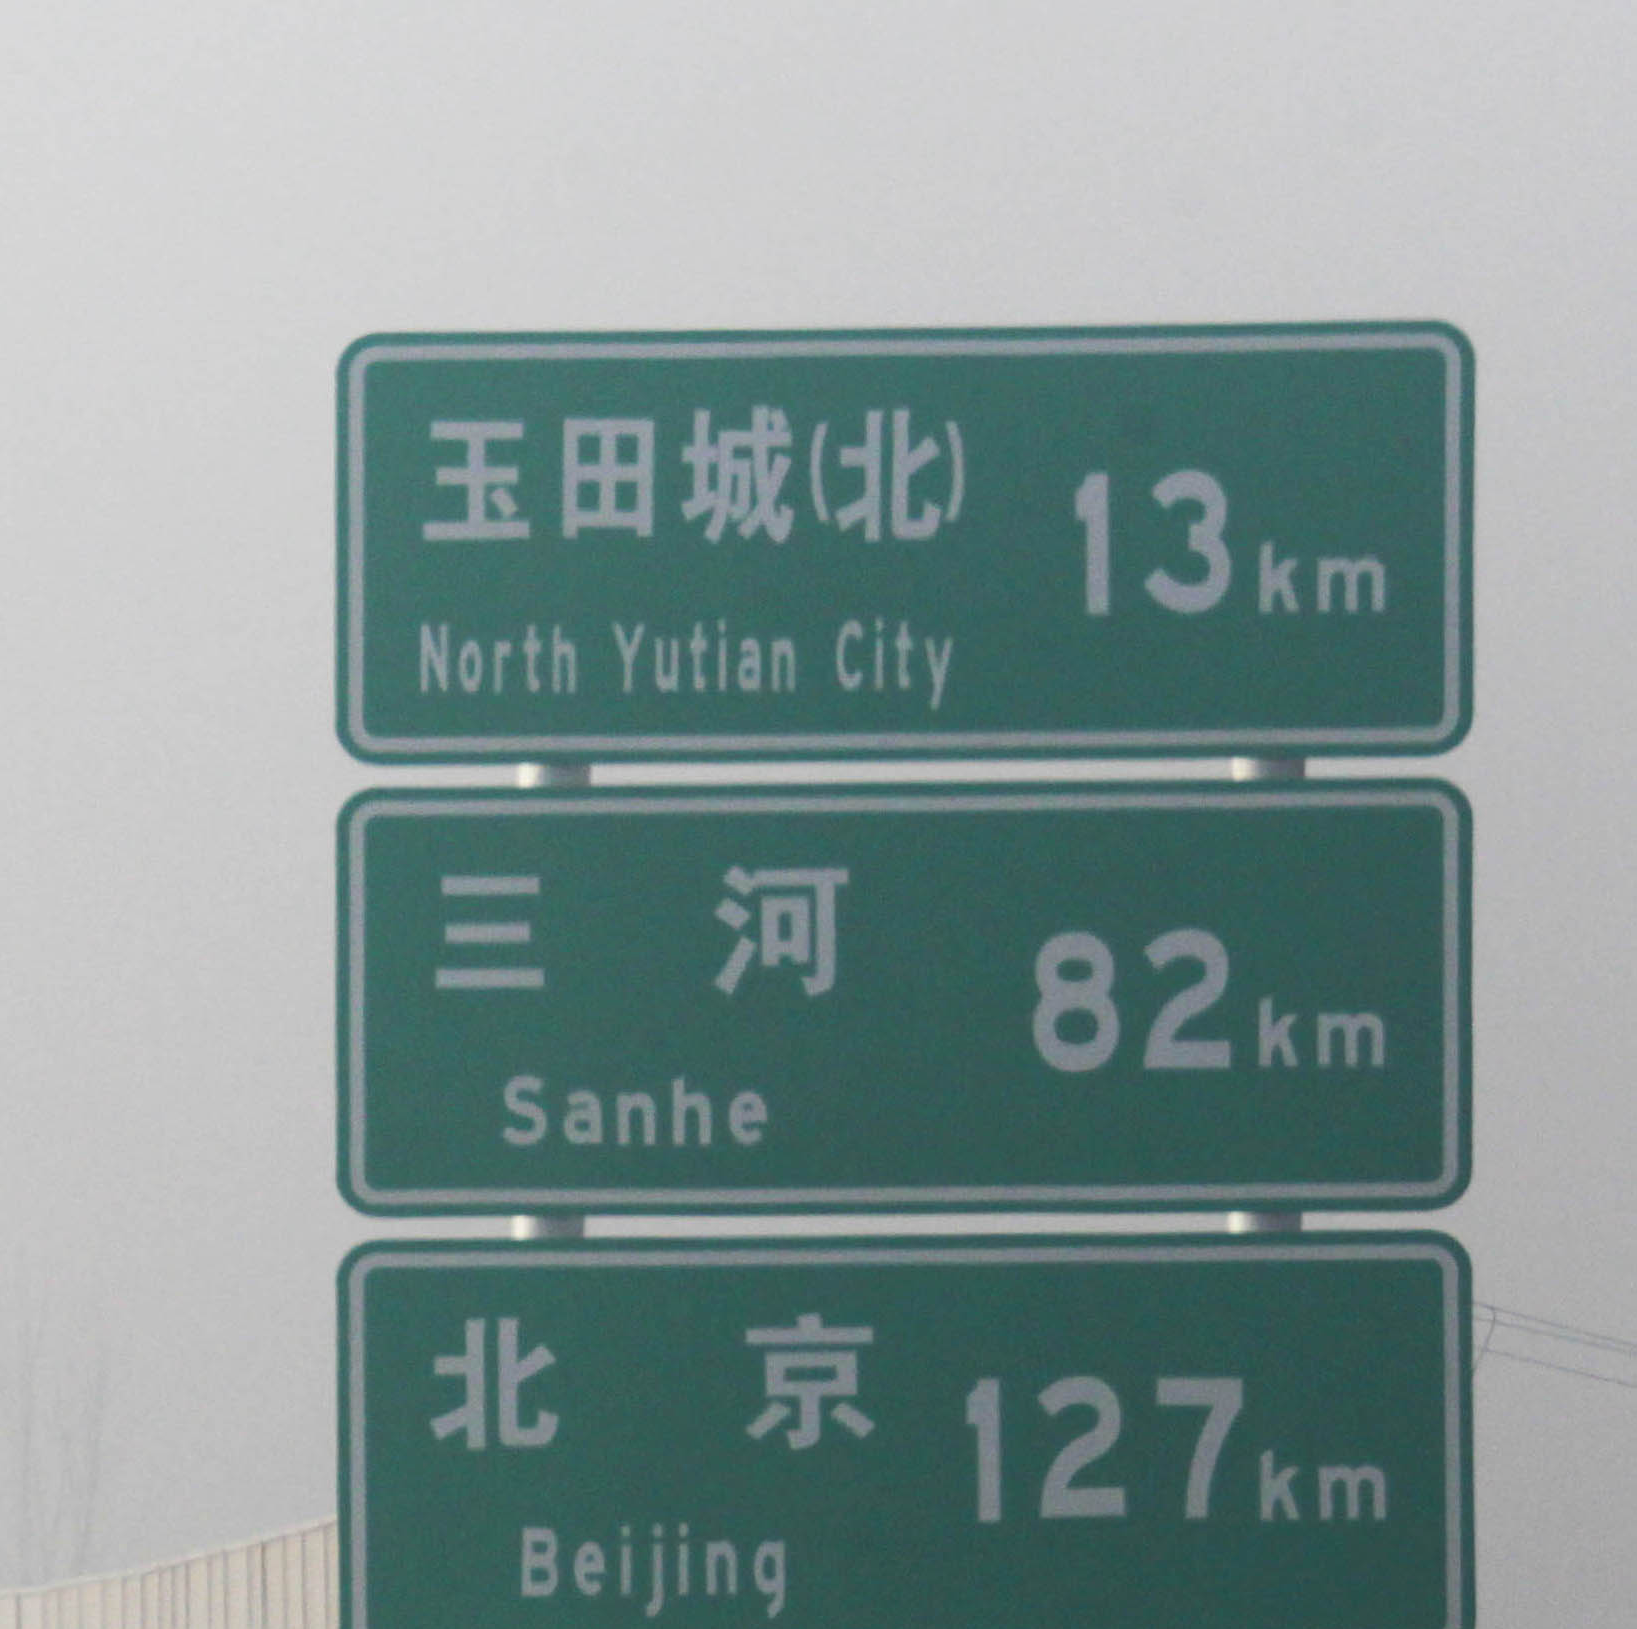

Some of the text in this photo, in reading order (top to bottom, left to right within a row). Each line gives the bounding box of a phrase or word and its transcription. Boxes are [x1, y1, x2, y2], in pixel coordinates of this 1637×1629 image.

[419, 618, 952, 709] North Yutian City
[503, 1075, 768, 1146] Sanhe
[521, 1523, 785, 1617] Beijing
